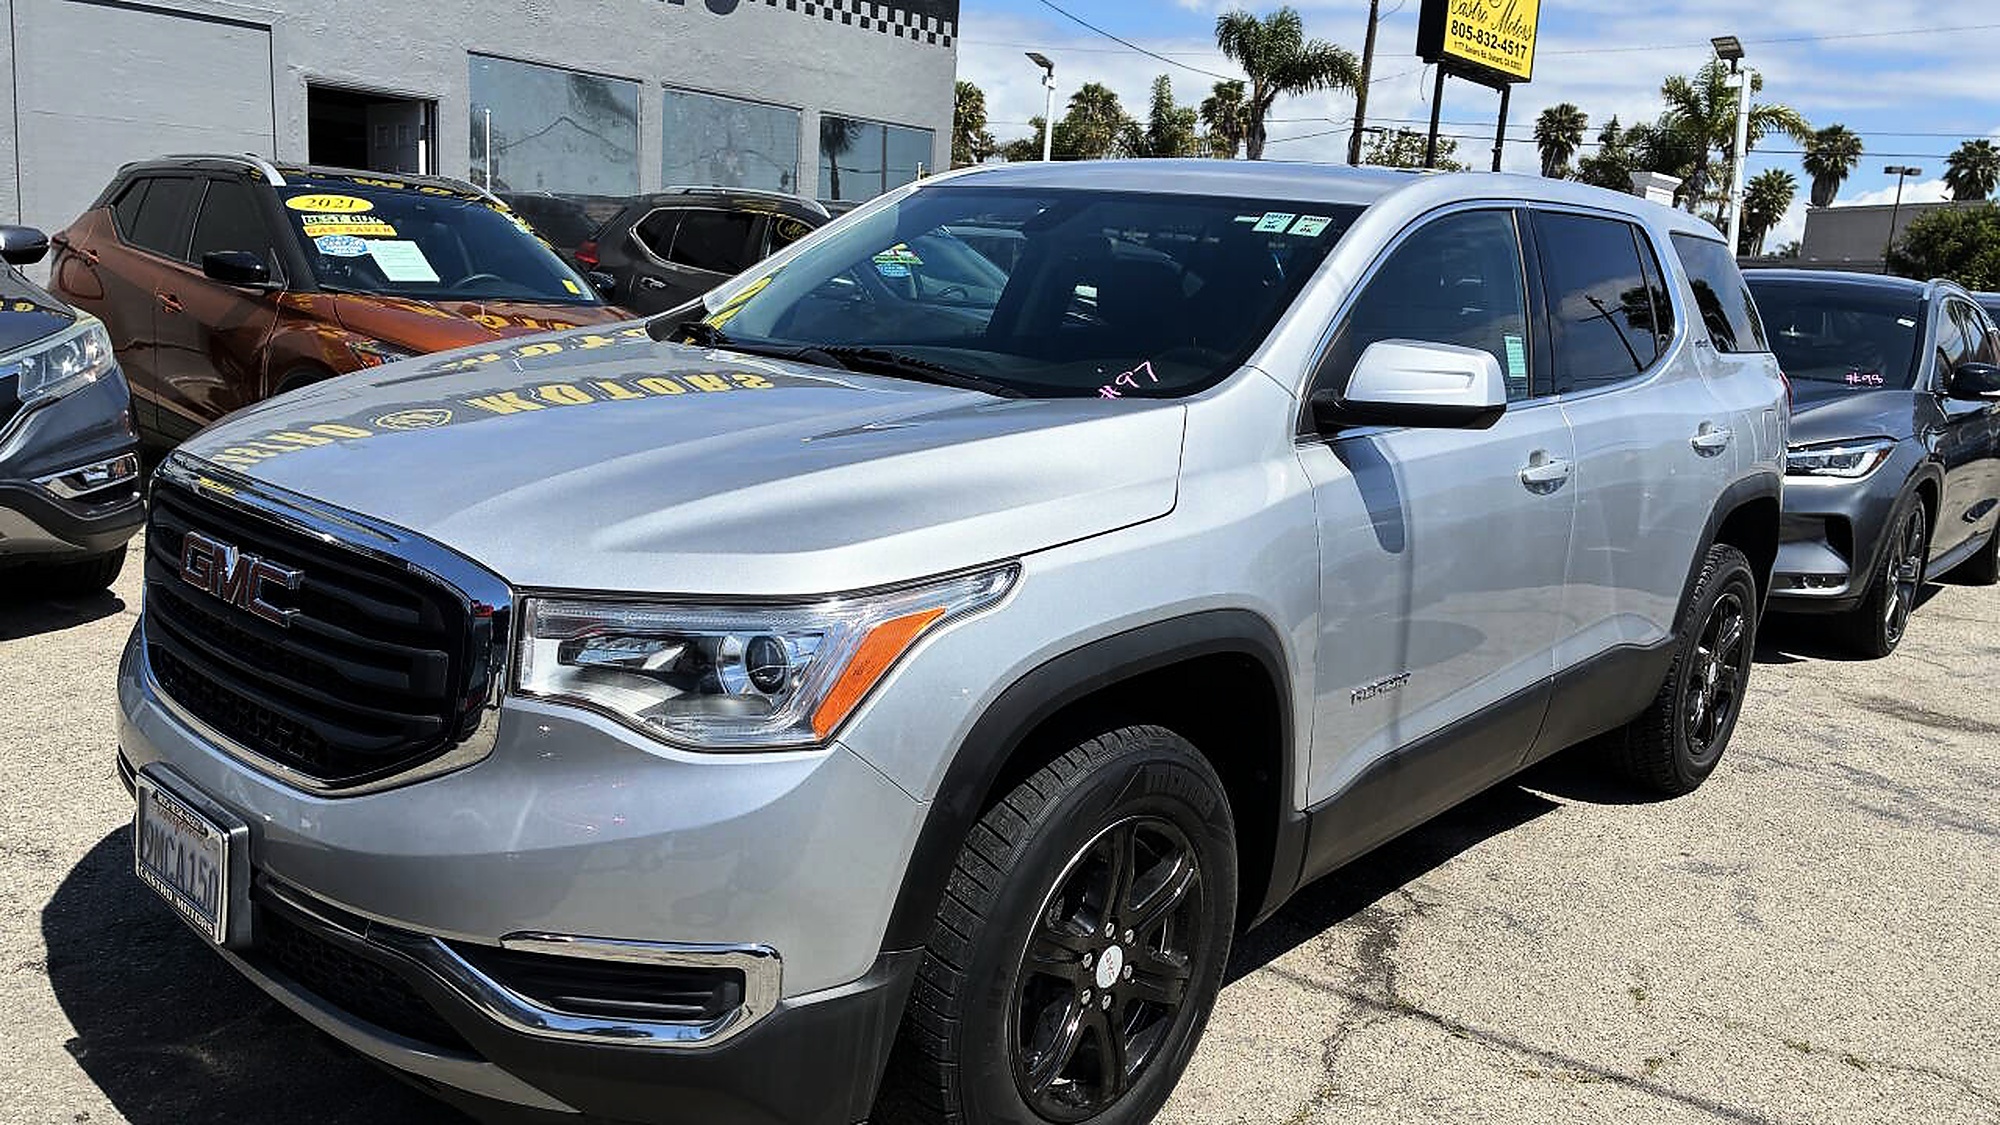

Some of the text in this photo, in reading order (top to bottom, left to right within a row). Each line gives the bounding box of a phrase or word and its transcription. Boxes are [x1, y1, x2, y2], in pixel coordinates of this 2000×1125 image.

[1451, 20, 1527, 59] 805-832-4517
[1491, 0, 1533, 41] Motors
[304, 215, 344, 224] BEST
[306, 198, 355, 209] 2021
[1098, 360, 1159, 400] #97
[179, 530, 304, 628] GMC
[139, 866, 215, 937] CASTRO MOTORS
